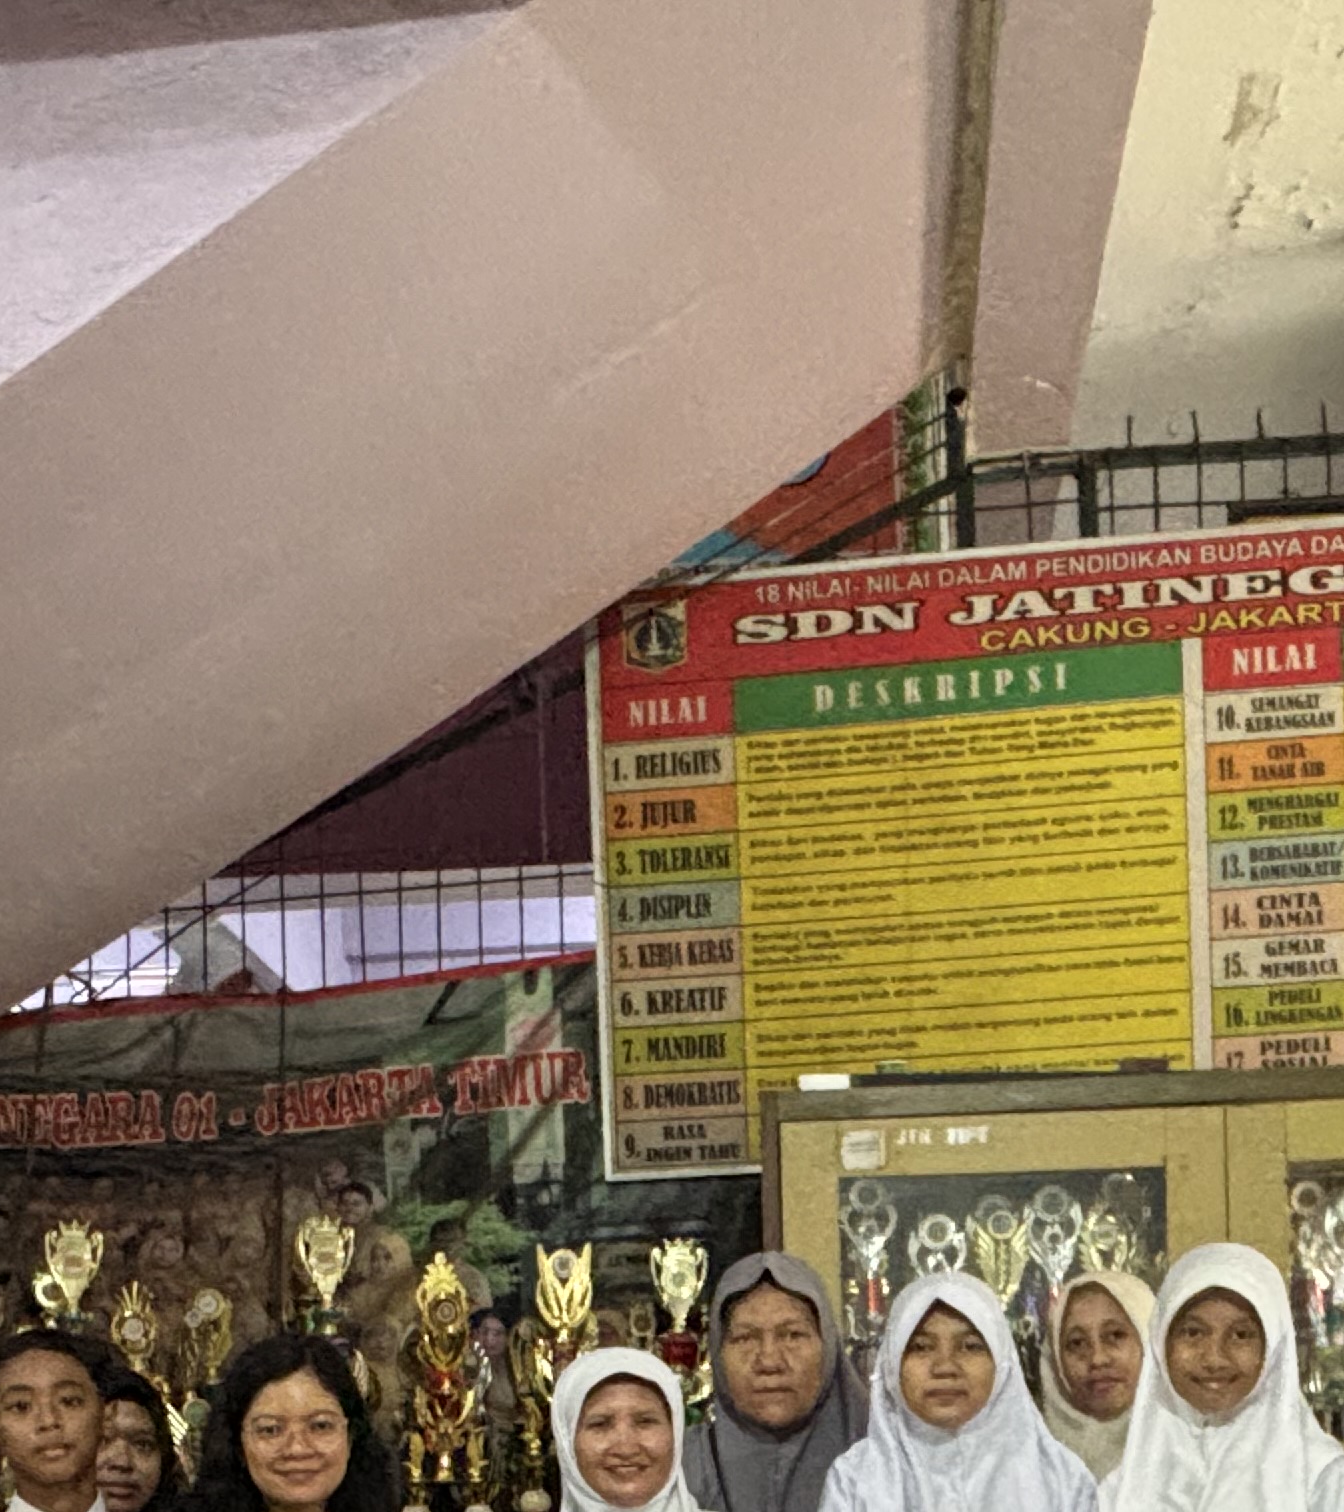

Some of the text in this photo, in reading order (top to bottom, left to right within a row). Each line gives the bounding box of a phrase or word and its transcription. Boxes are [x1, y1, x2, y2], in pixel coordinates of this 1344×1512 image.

[755, 583, 780, 604] 18
[867, 570, 929, 594] NILAI
[938, 560, 1027, 588] DALAM
[1035, 545, 1192, 579] PENDIDIKAN
[1200, 535, 1304, 565] BUDAYA
[733, 601, 922, 646] SDN
[979, 615, 1152, 653] CAKUNG
[1232, 643, 1318, 677] NILAI
[813, 662, 1068, 713] DESKRIPSI
[629, 695, 707, 728] NILAI
[1216, 704, 1241, 732] 10.
[612, 748, 723, 782] 1. RELIGIUS
[1218, 755, 1240, 782] 11.
[614, 799, 697, 831] 2. JUJUR
[1218, 804, 1245, 831] 12.
[615, 844, 731, 876] 3. TOLERANSI
[1221, 853, 1245, 881] 13.
[617, 892, 712, 923] 4. DISIPLIN
[1256, 891, 1322, 910] CINTA
[1222, 902, 1247, 930] 14.
[1258, 909, 1324, 929] DAMAI
[617, 945, 634, 969] 5.
[687, 937, 734, 966] KERAS
[1264, 938, 1326, 957] GEMAR
[1223, 951, 1249, 980] 15.
[1259, 958, 1339, 979] MEMBACA
[620, 986, 727, 1017] 6. KREATIF
[1268, 987, 1321, 1007] PEDULI
[1225, 1002, 1250, 1028] 16.
[622, 1038, 641, 1064] 7.
[647, 1032, 727, 1062] MANDIRI
[1260, 1034, 1331, 1056] PEDULI
[172, 1090, 219, 1142] 01
[254, 1062, 443, 1137] JAKARTA
[448, 1047, 590, 1117] TIMUR
[623, 1079, 742, 1111] 8. DEMOKRATIS
[624, 1133, 641, 1159] 9.
[662, 1123, 707, 1141] RASA
